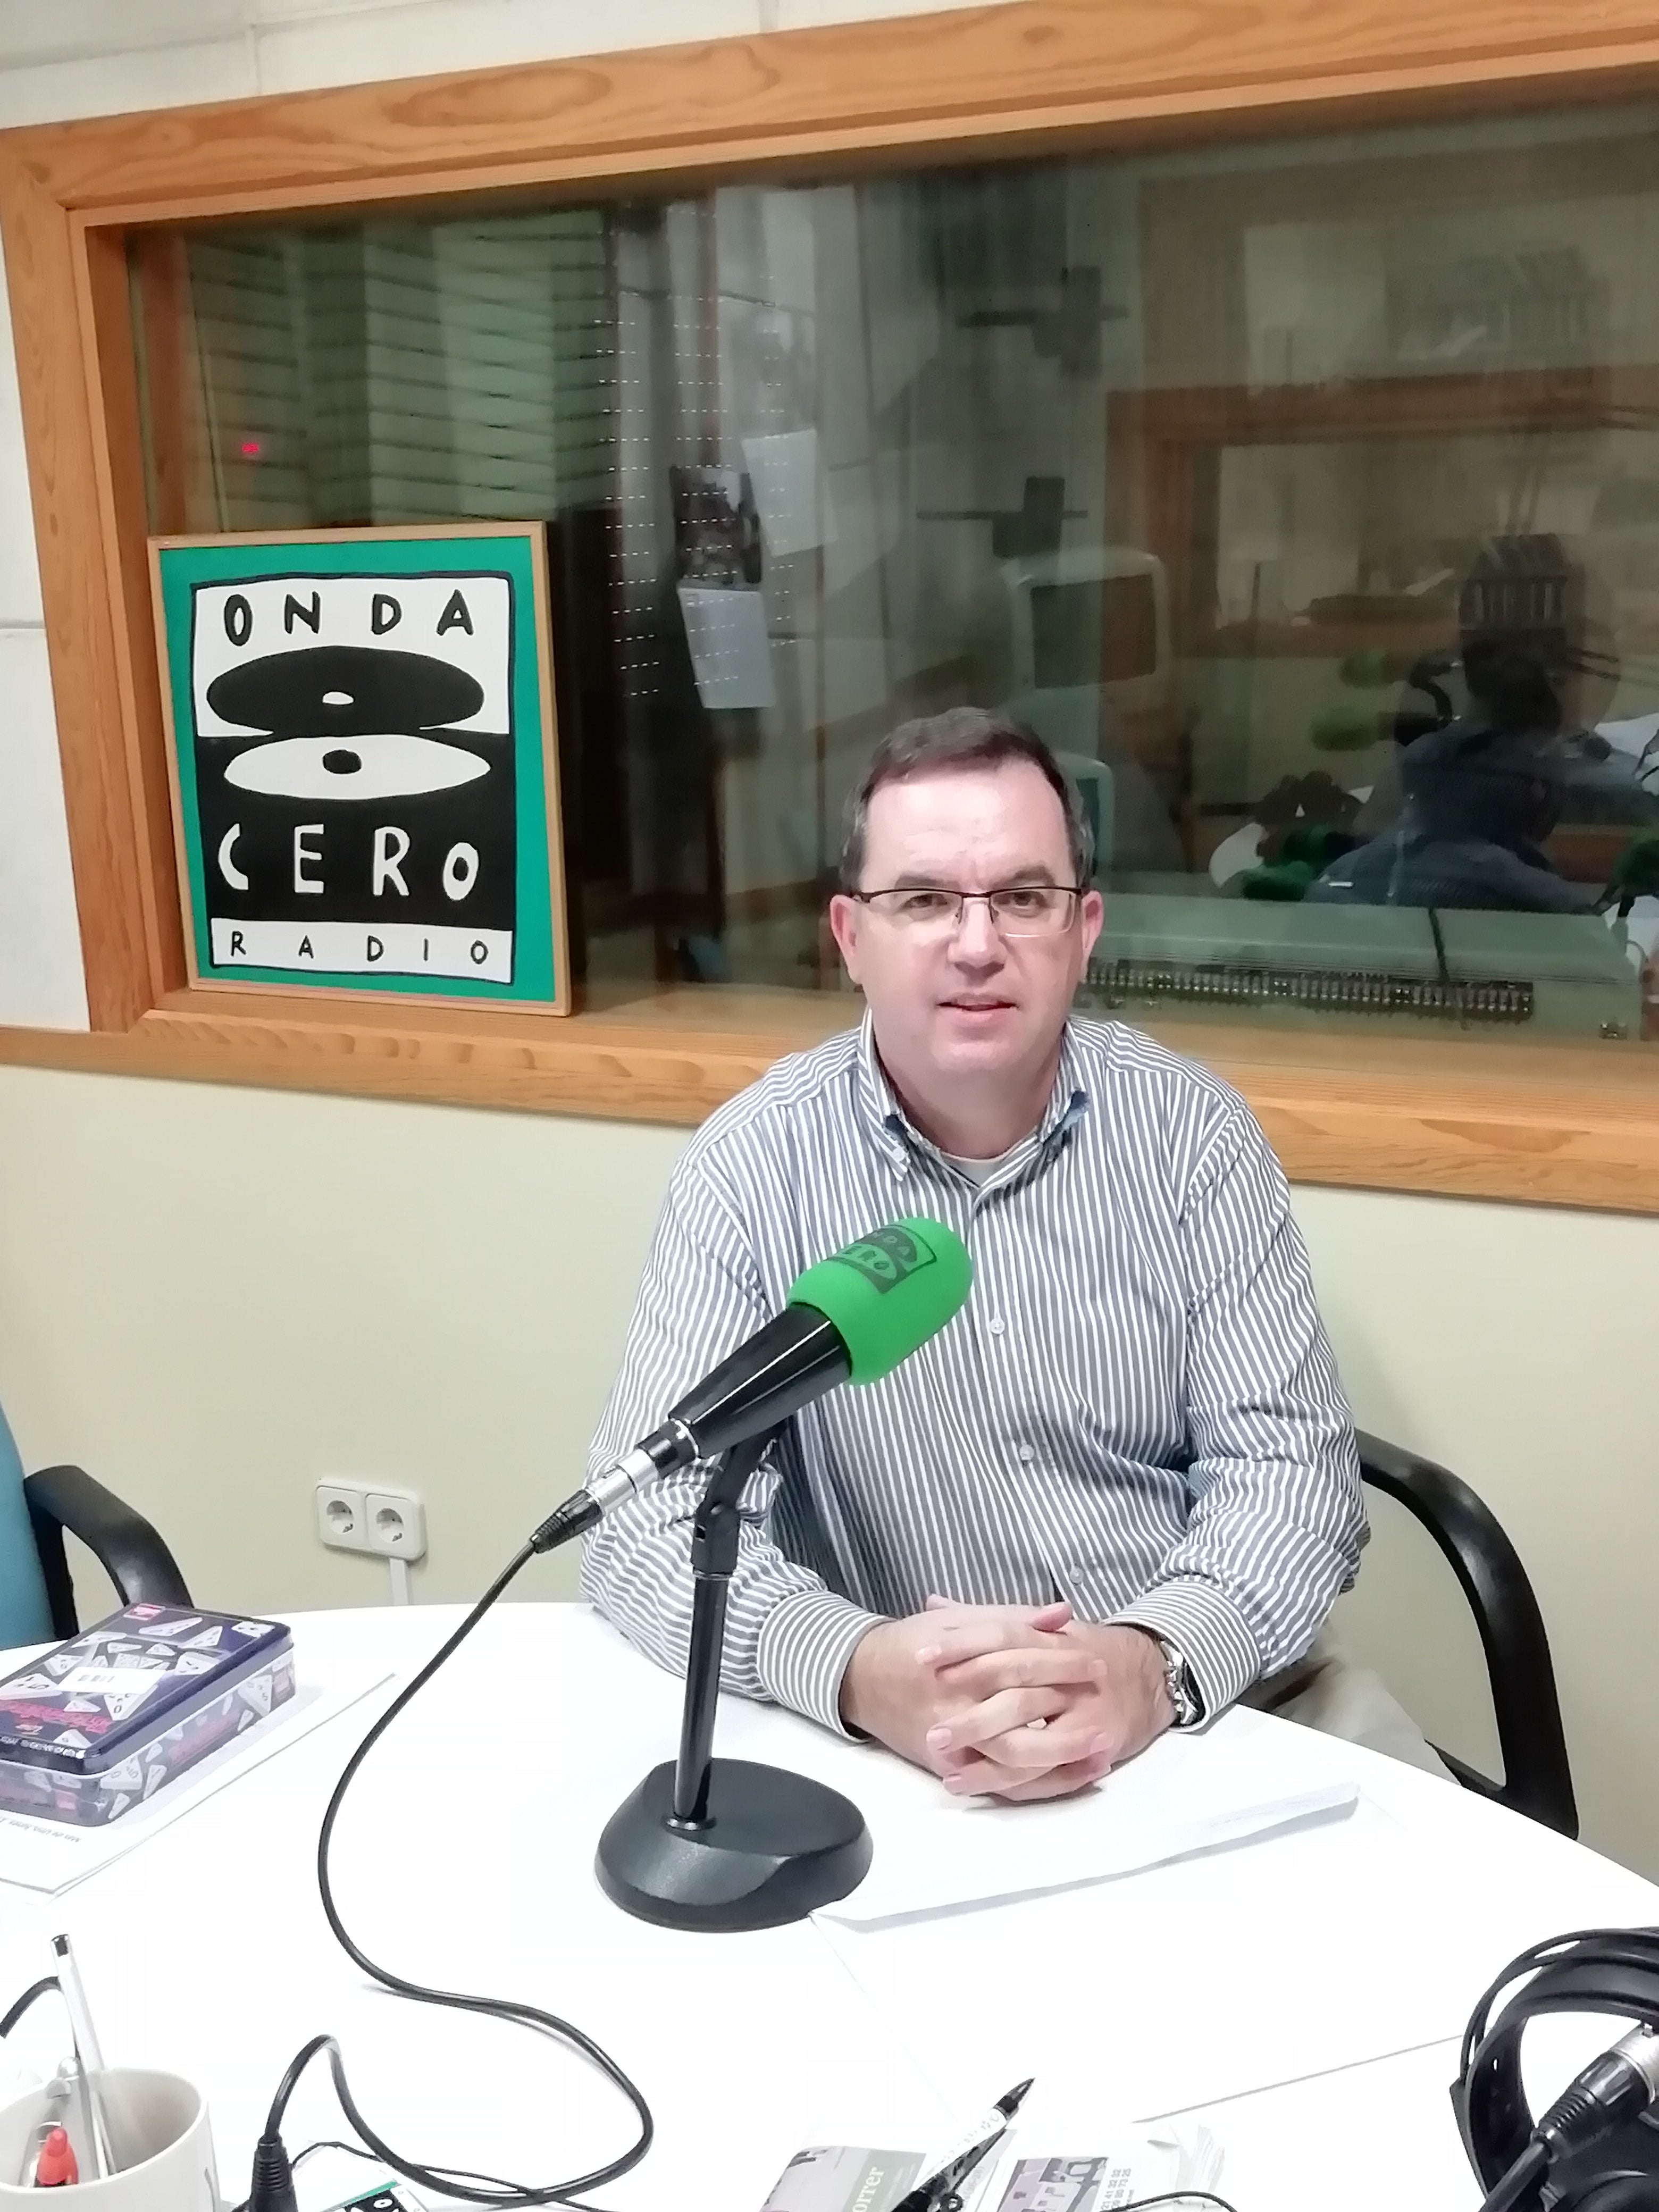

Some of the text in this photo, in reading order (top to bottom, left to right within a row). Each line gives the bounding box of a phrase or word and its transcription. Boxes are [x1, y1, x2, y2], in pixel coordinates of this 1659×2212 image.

[224, 589, 474, 646] ONDA
[218, 823, 479, 901] CERO
[230, 931, 489, 965] RADIO
[852, 2166, 885, 2212] orrer
